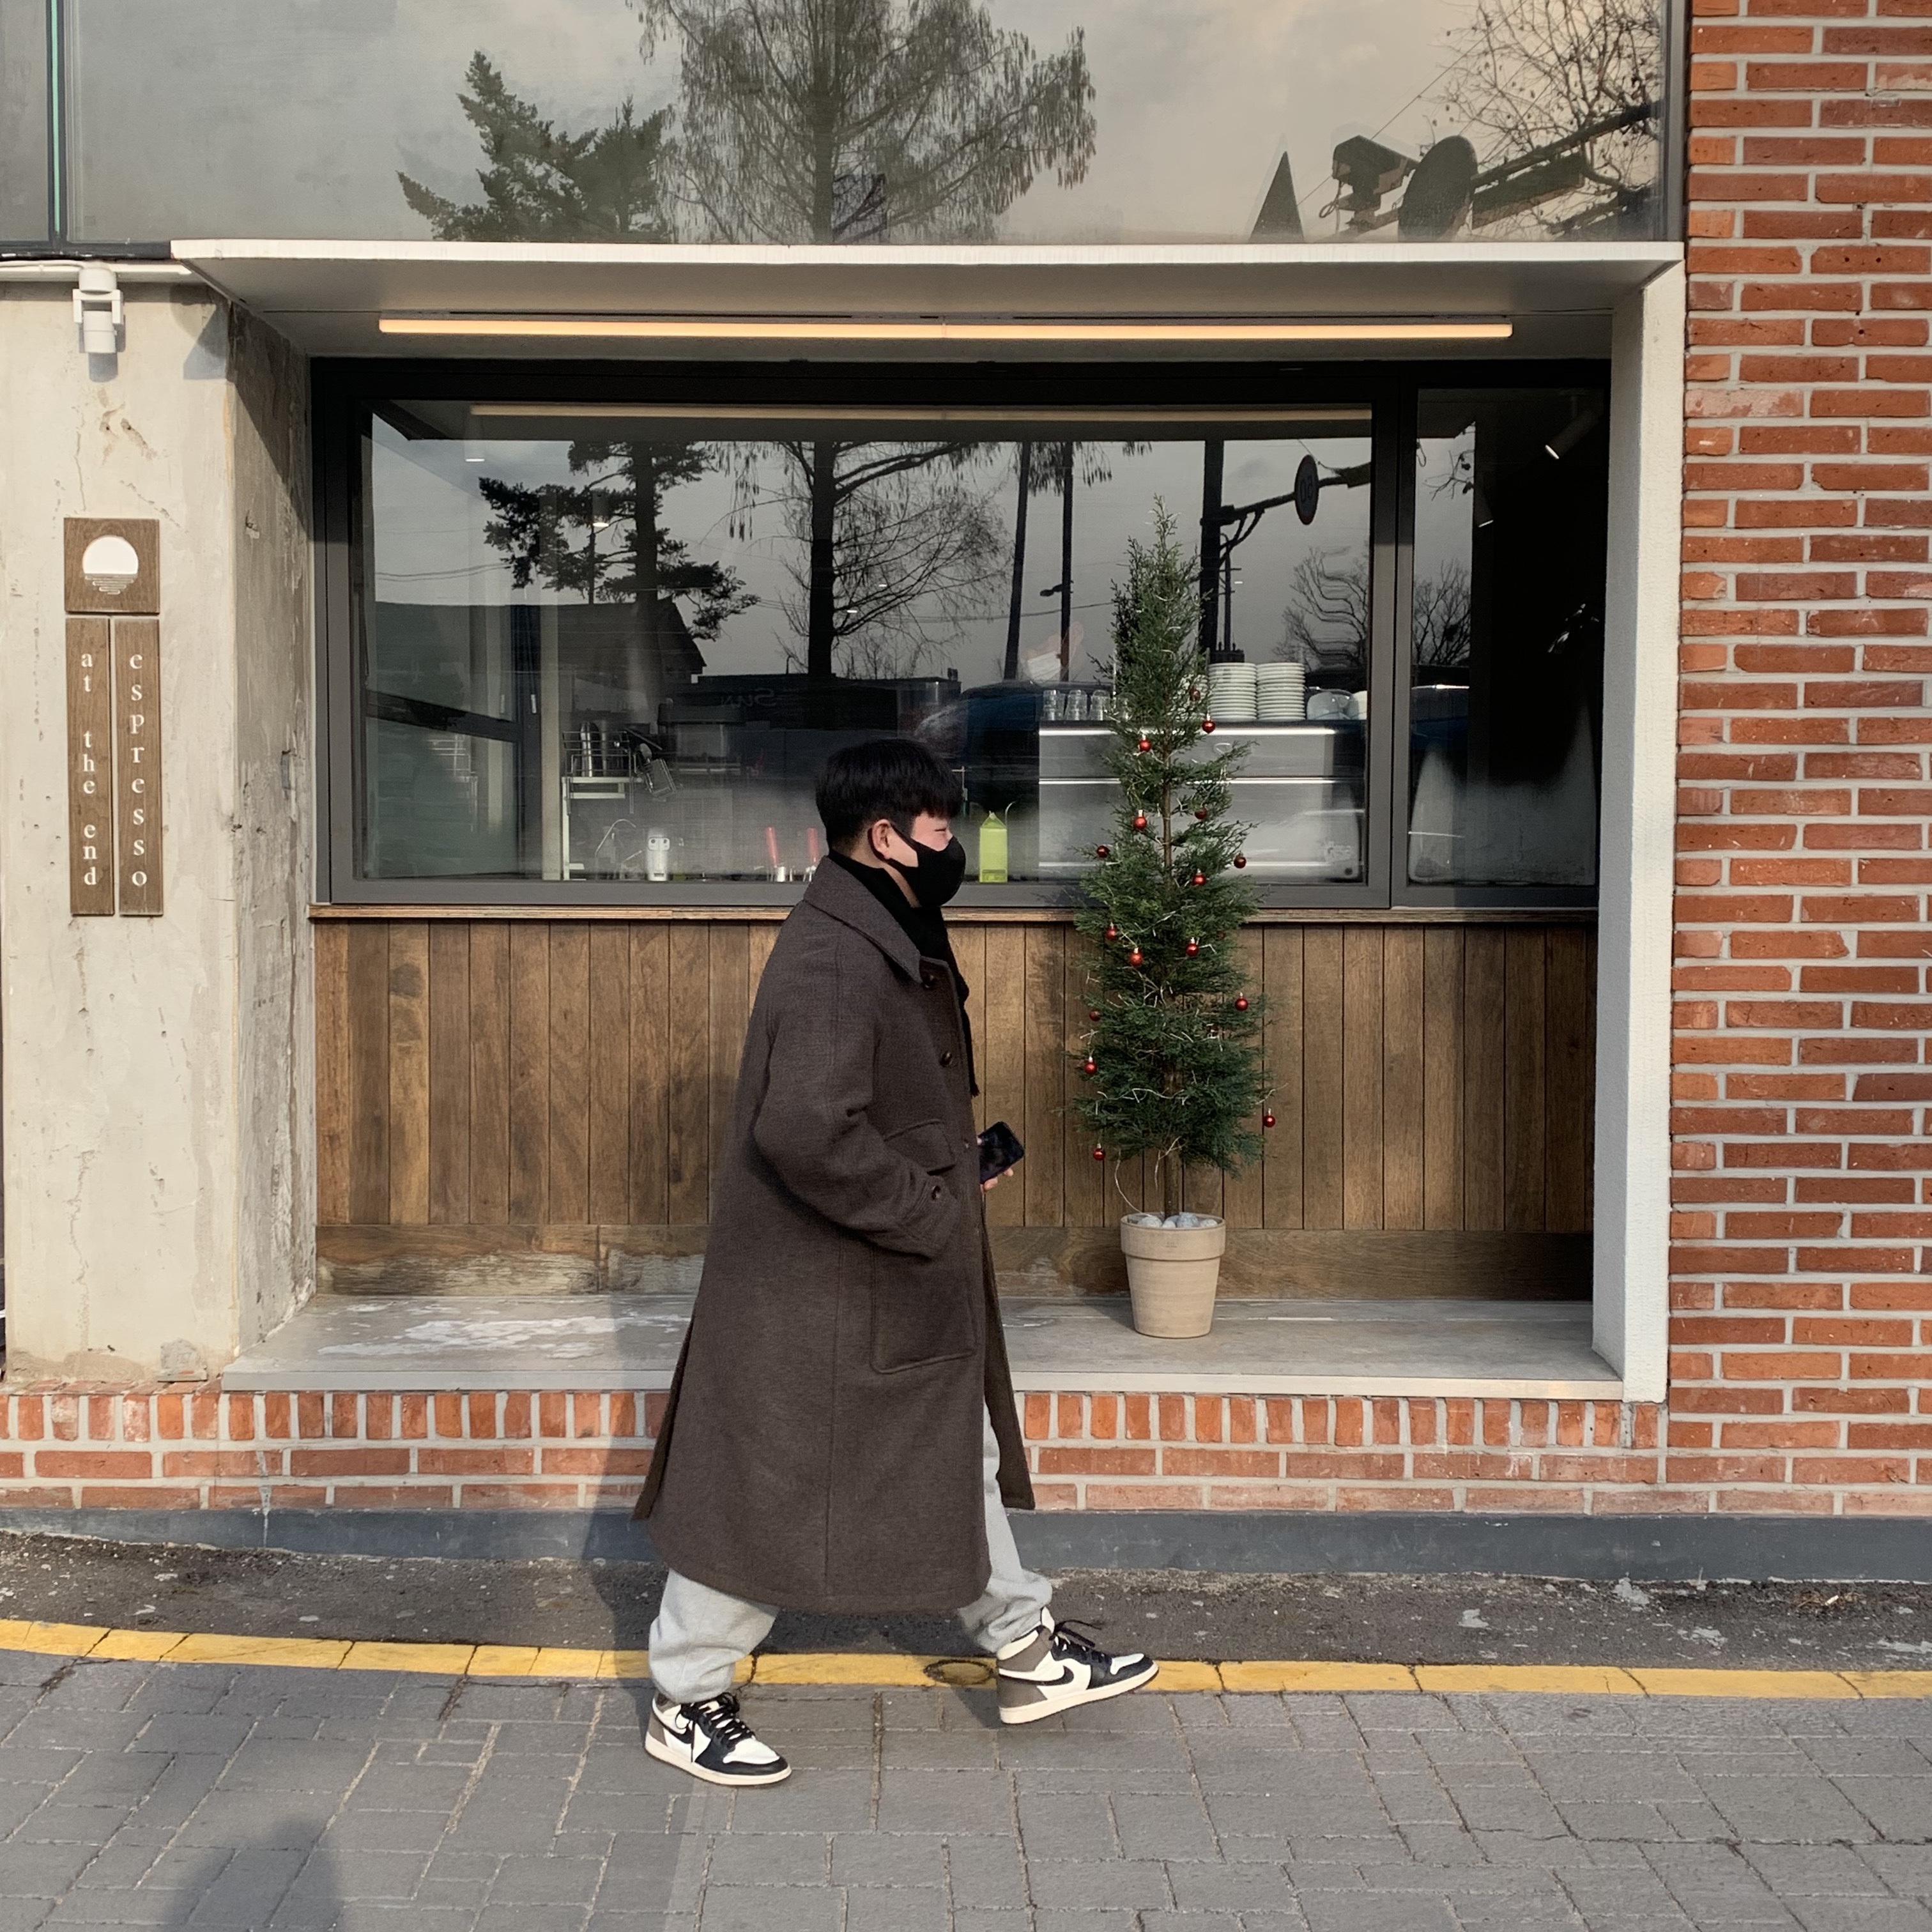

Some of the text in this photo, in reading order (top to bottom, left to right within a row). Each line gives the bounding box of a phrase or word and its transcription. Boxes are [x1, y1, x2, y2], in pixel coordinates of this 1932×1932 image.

[80, 653, 98, 886] at the end
[129, 654, 148, 887] espresso
